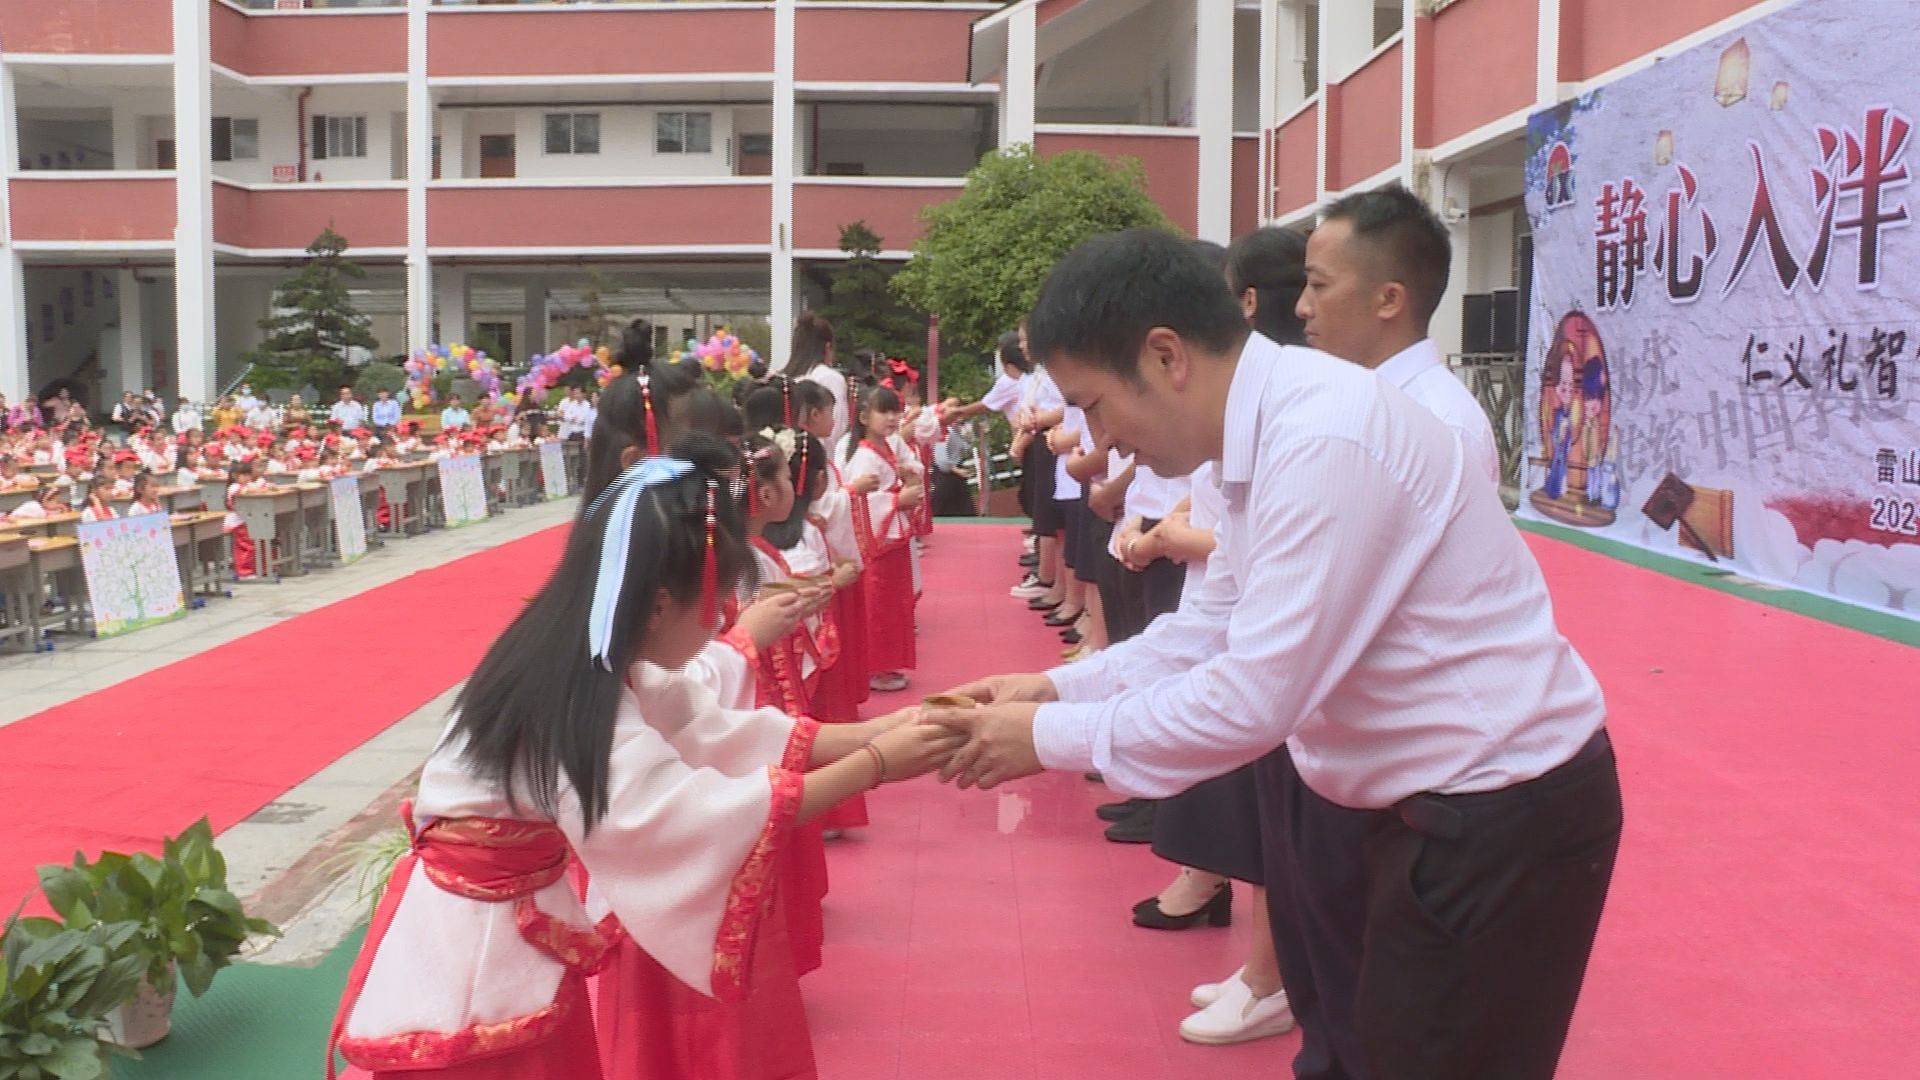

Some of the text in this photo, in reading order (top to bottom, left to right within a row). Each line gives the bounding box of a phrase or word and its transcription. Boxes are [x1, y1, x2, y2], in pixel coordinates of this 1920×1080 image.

[1594, 106, 1912, 308] 静心入泮
[1741, 326, 1920, 399] 仁义礼智
[1876, 447, 1920, 485] 雷山
[1871, 497, 1920, 532] 202
